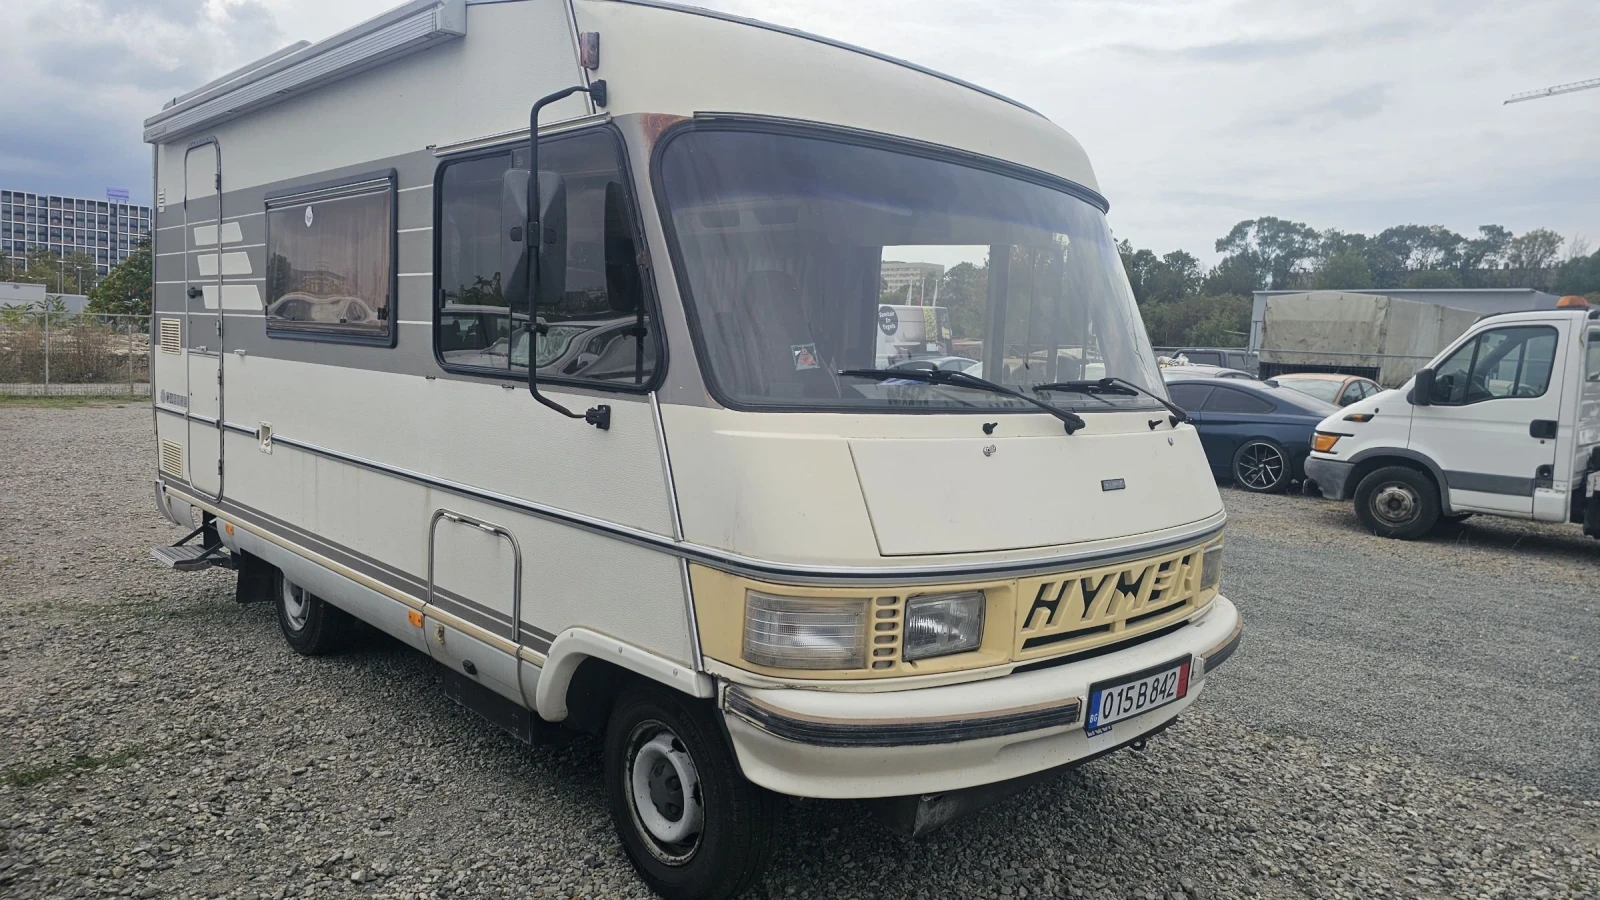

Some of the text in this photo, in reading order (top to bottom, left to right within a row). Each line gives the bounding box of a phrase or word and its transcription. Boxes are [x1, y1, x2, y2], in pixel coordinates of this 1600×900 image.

[1021, 555, 1195, 633] HYMER
[1089, 713, 1098, 724] BG
[1103, 672, 1177, 719] 015B842
